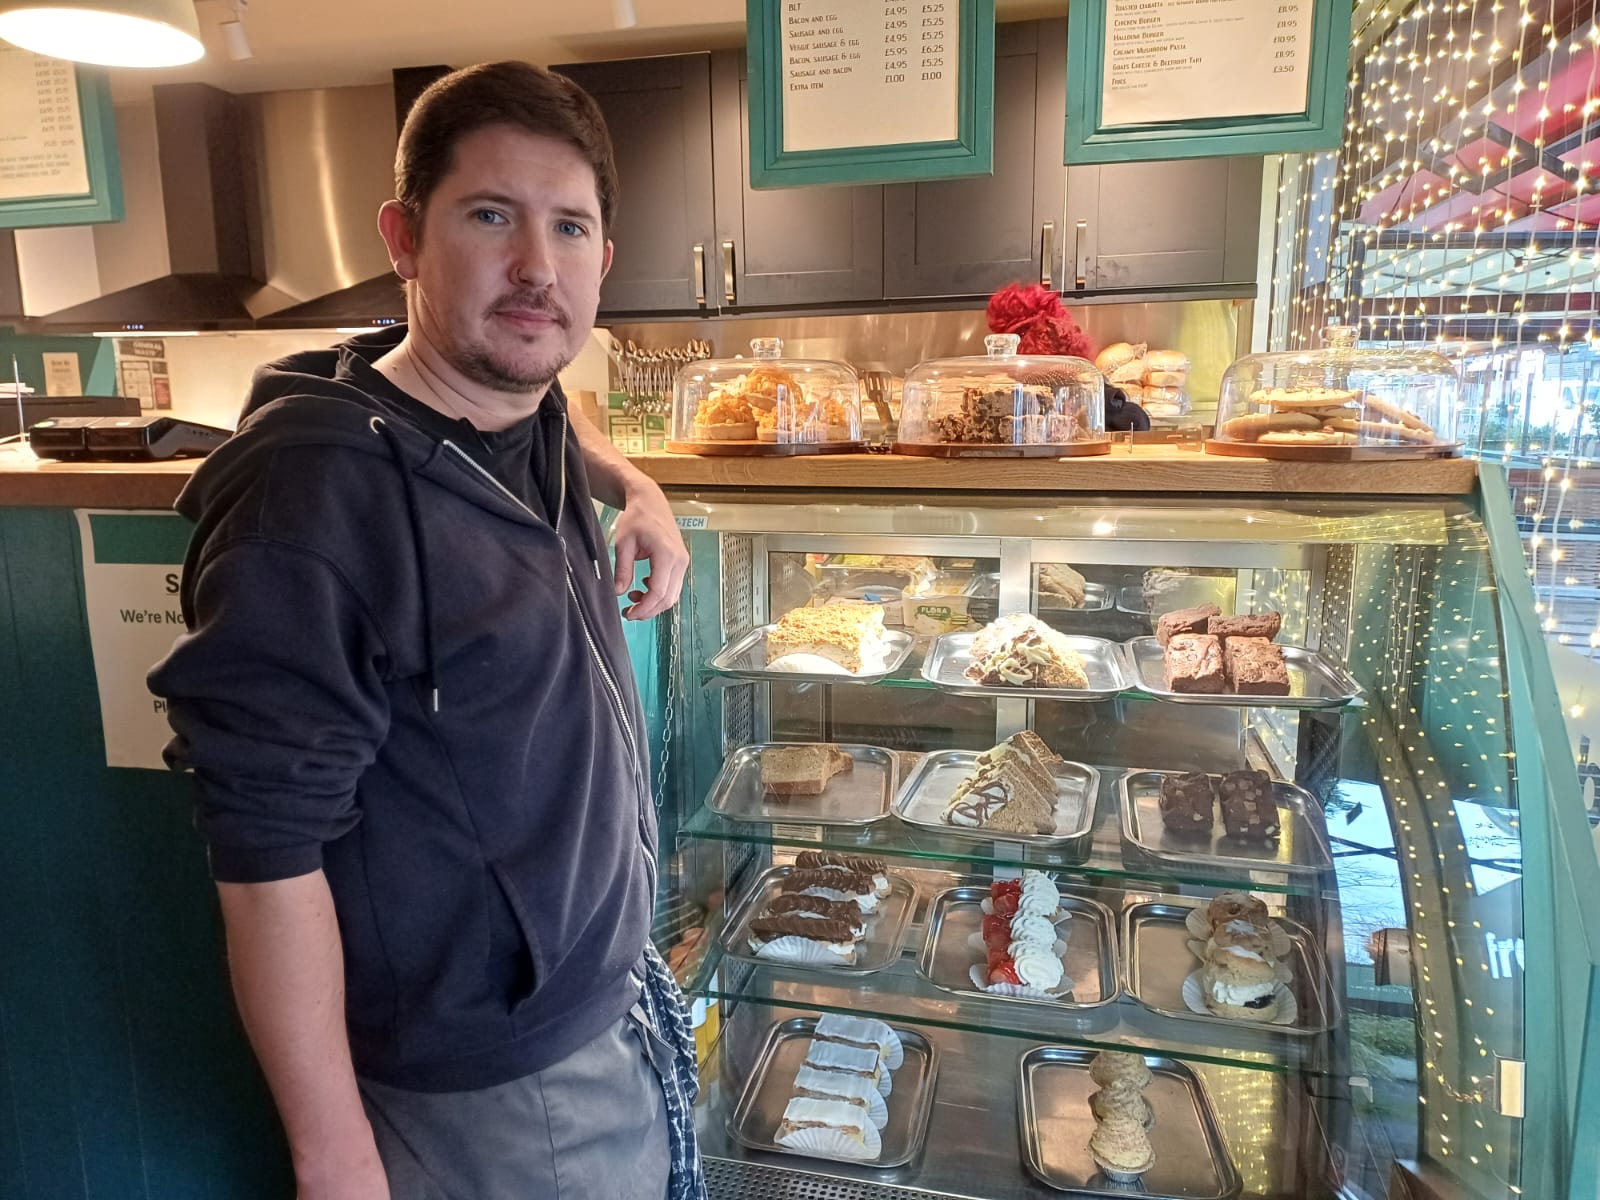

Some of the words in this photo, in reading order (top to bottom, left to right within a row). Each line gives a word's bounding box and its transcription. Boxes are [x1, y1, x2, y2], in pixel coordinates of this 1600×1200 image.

[789, 3, 800, 11] BLT
[885, 7, 908, 16] £4.95
[922, 4, 944, 13] £5.25
[885, 20, 908, 29] £4.95
[922, 17, 944, 27] £5.25
[885, 34, 907, 43] £4.95
[922, 31, 944, 40] £5.25
[885, 47, 907, 56] £5.95
[921, 45, 944, 53] £6.25
[885, 61, 907, 70] £4.95
[922, 58, 944, 67] £5.25
[885, 74, 904, 83] £1.00
[921, 72, 942, 80] £1.00
[674, 518, 704, 527] -TECH
[120, 609, 161, 623] We're
